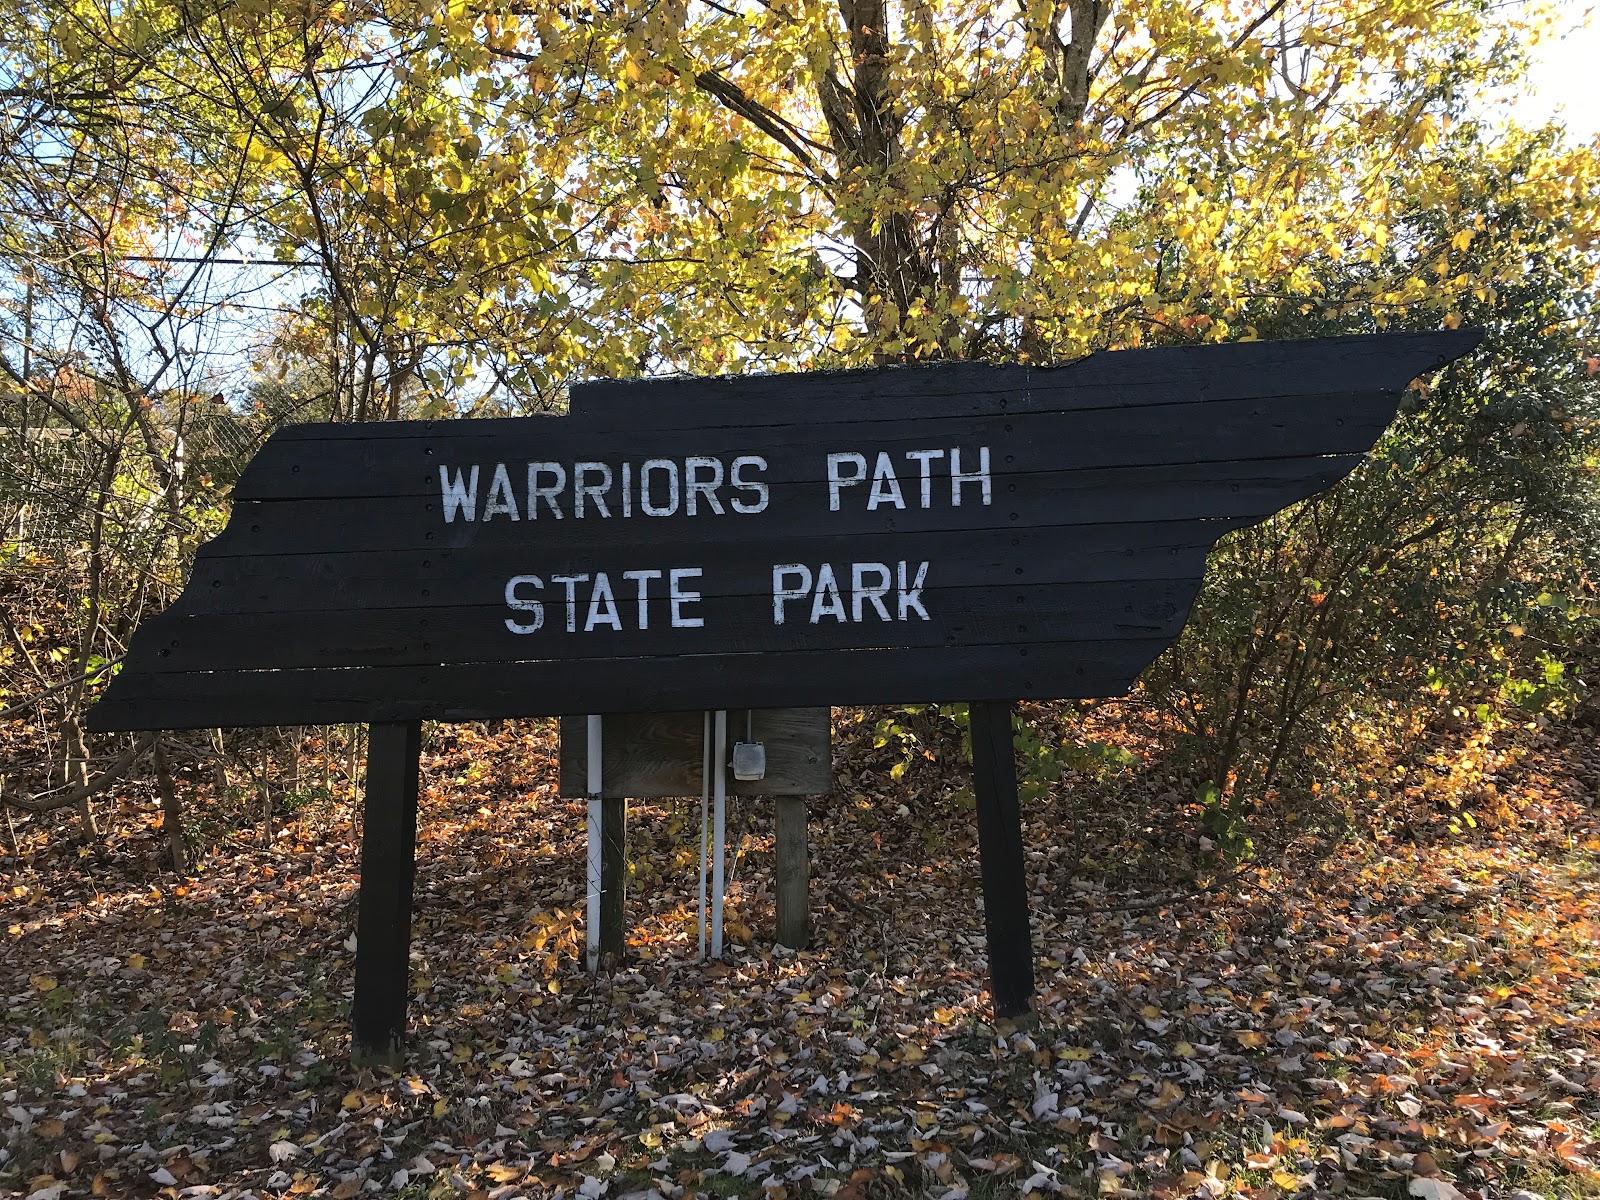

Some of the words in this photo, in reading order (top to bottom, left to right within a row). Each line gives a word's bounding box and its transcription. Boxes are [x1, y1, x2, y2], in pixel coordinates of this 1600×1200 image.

[438, 456, 769, 523] WARRIORS
[827, 446, 992, 511] PATH
[504, 567, 705, 634] STATE
[772, 560, 932, 625] PARK
